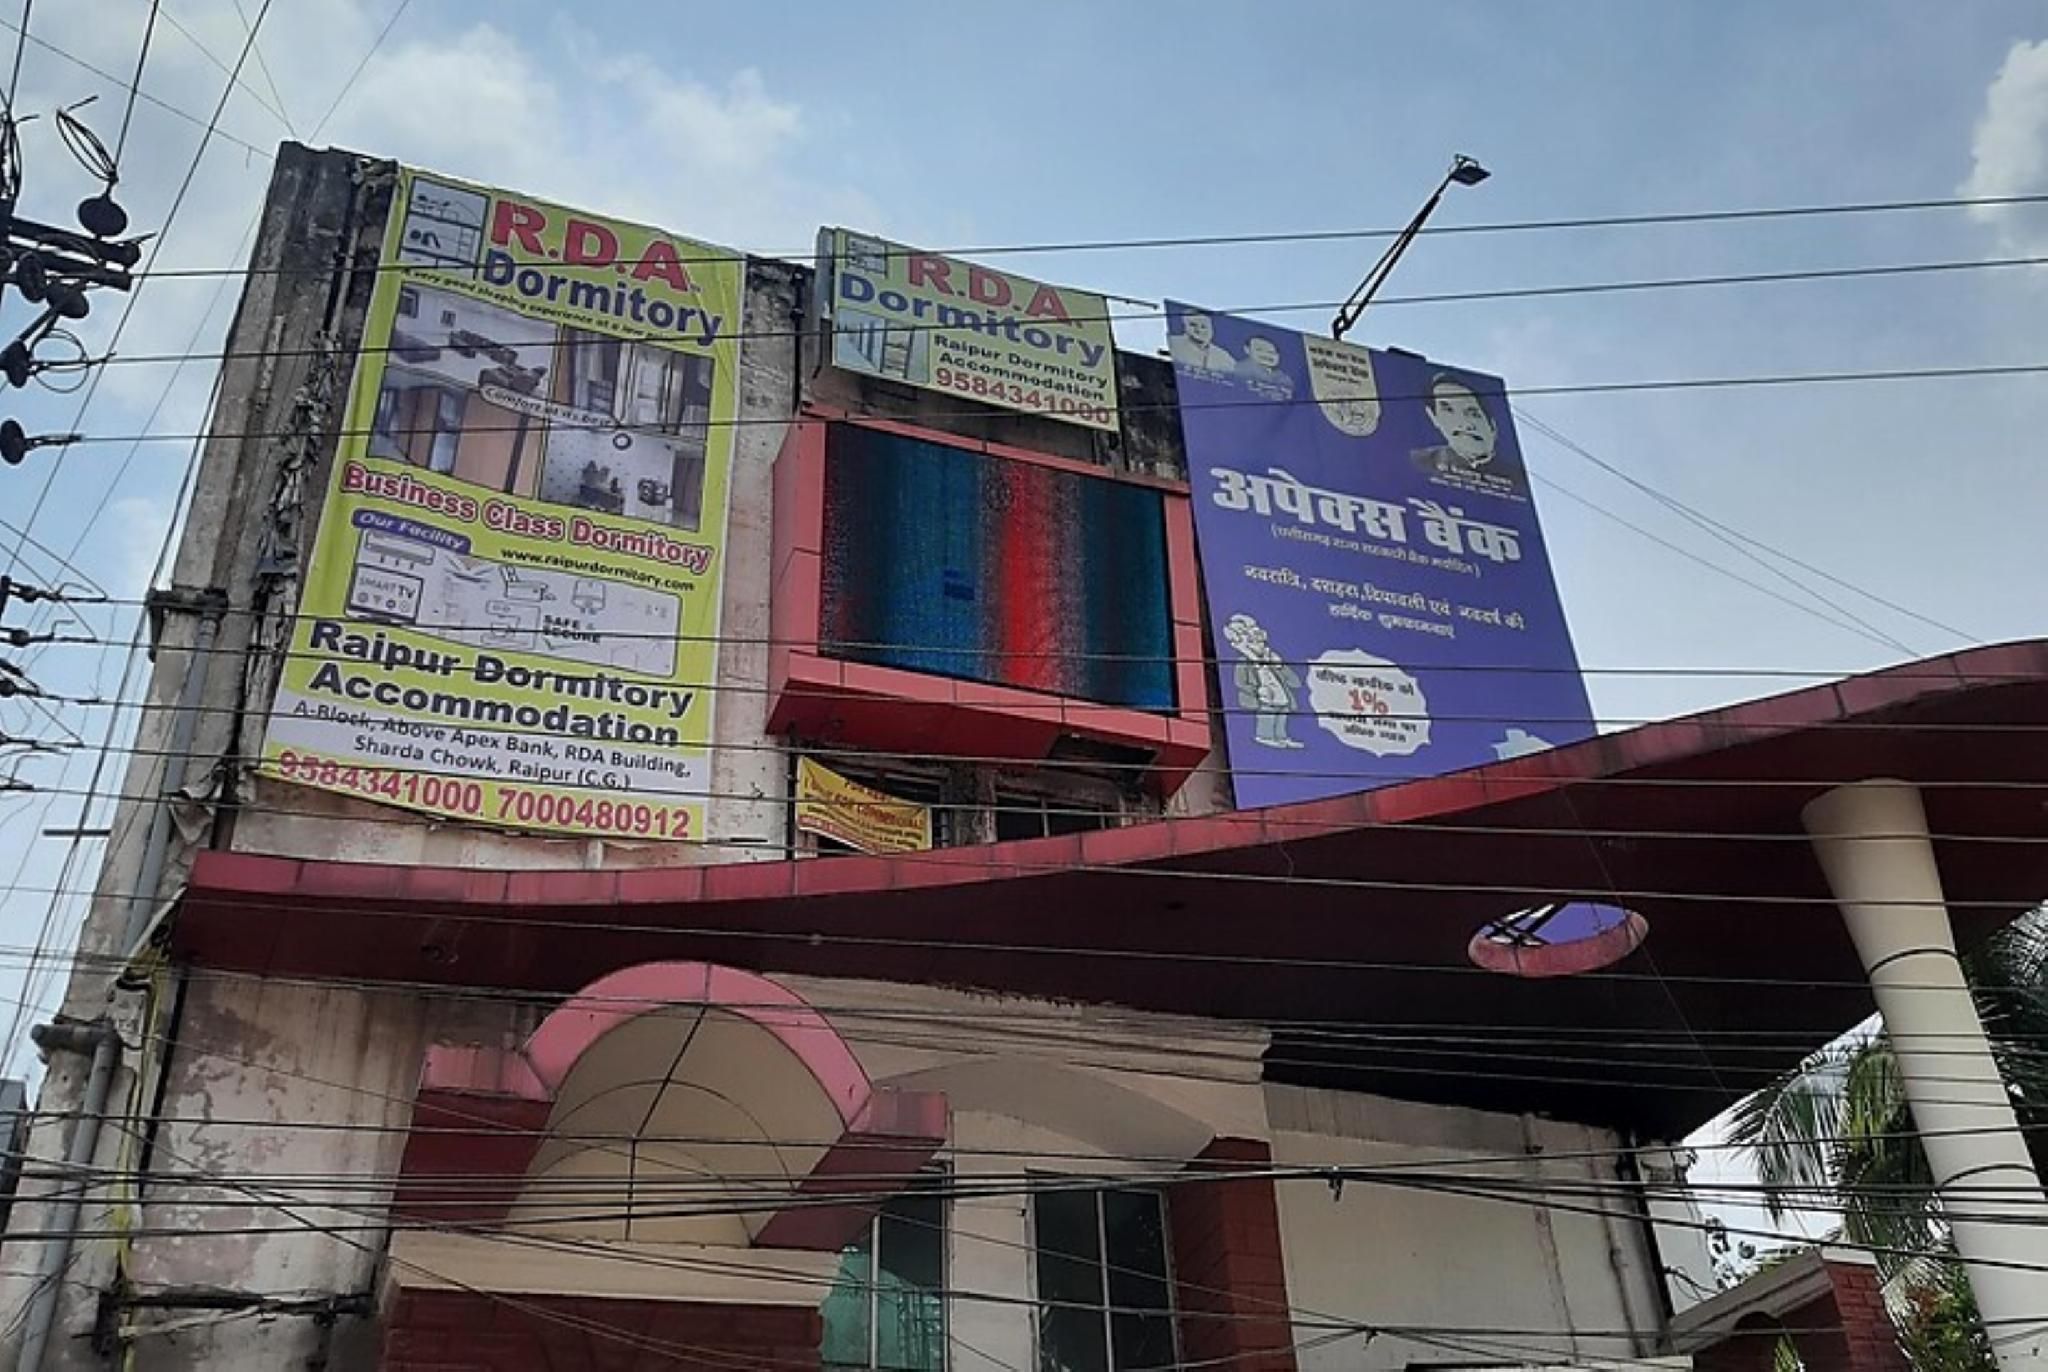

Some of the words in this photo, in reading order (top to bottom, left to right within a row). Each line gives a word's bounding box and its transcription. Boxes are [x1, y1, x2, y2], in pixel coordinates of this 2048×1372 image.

[482, 248, 722, 347] Dormitory
[840, 272, 1105, 367] Dormitory
[934, 334, 1001, 360] Raipur
[1008, 352, 1107, 389] Dormitory
[940, 351, 1105, 401] Accommodation
[936, 367, 1110, 425] 9584341000
[343, 462, 478, 521] Business
[483, 502, 565, 542] Class
[570, 519, 713, 573] Dormitory
[359, 513, 393, 529] Our
[398, 521, 465, 549] Facility
[1211, 467, 1407, 543] अपेक्स
[1407, 497, 1520, 561] बैंक
[501, 550, 695, 592] www.raipurdormitory.com
[309, 620, 461, 674] Raipur
[474, 654, 693, 719] Dormitory
[309, 662, 679, 748] Accommodation
[1348, 688, 1389, 715] 1%
[354, 734, 424, 761] Sharda
[430, 748, 502, 775] Chowk,
[509, 758, 572, 785] Raipur
[382, 717, 445, 742] Above
[450, 728, 499, 750] Apex
[505, 738, 559, 760] Bank,
[564, 744, 605, 764] RDA
[610, 753, 692, 778] Building,
[497, 788, 691, 839] 7000480912
